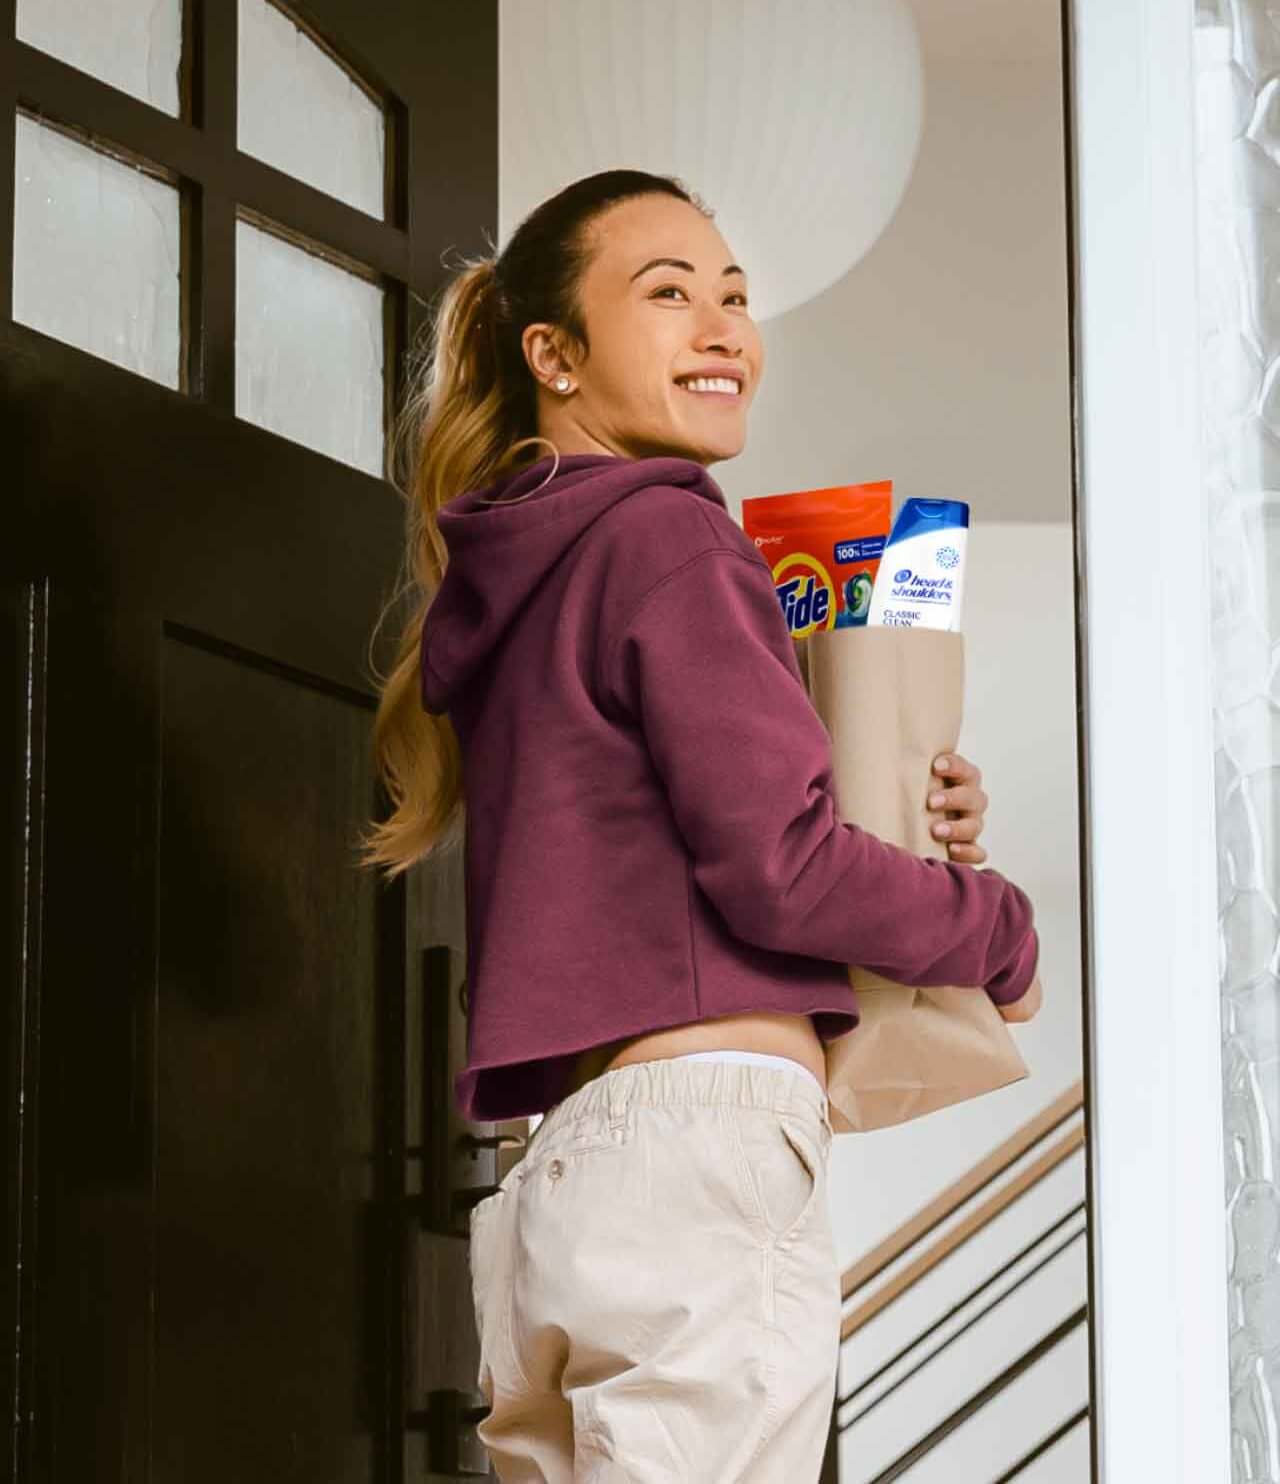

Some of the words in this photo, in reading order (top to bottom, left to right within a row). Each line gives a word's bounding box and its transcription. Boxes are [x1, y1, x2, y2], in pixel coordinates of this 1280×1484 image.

[836, 548, 860, 561] 100%
[891, 585, 953, 600] shoulders
[776, 576, 829, 630] Tide
[883, 609, 921, 621] CLASSIC
[882, 618, 913, 627] CLEAN
